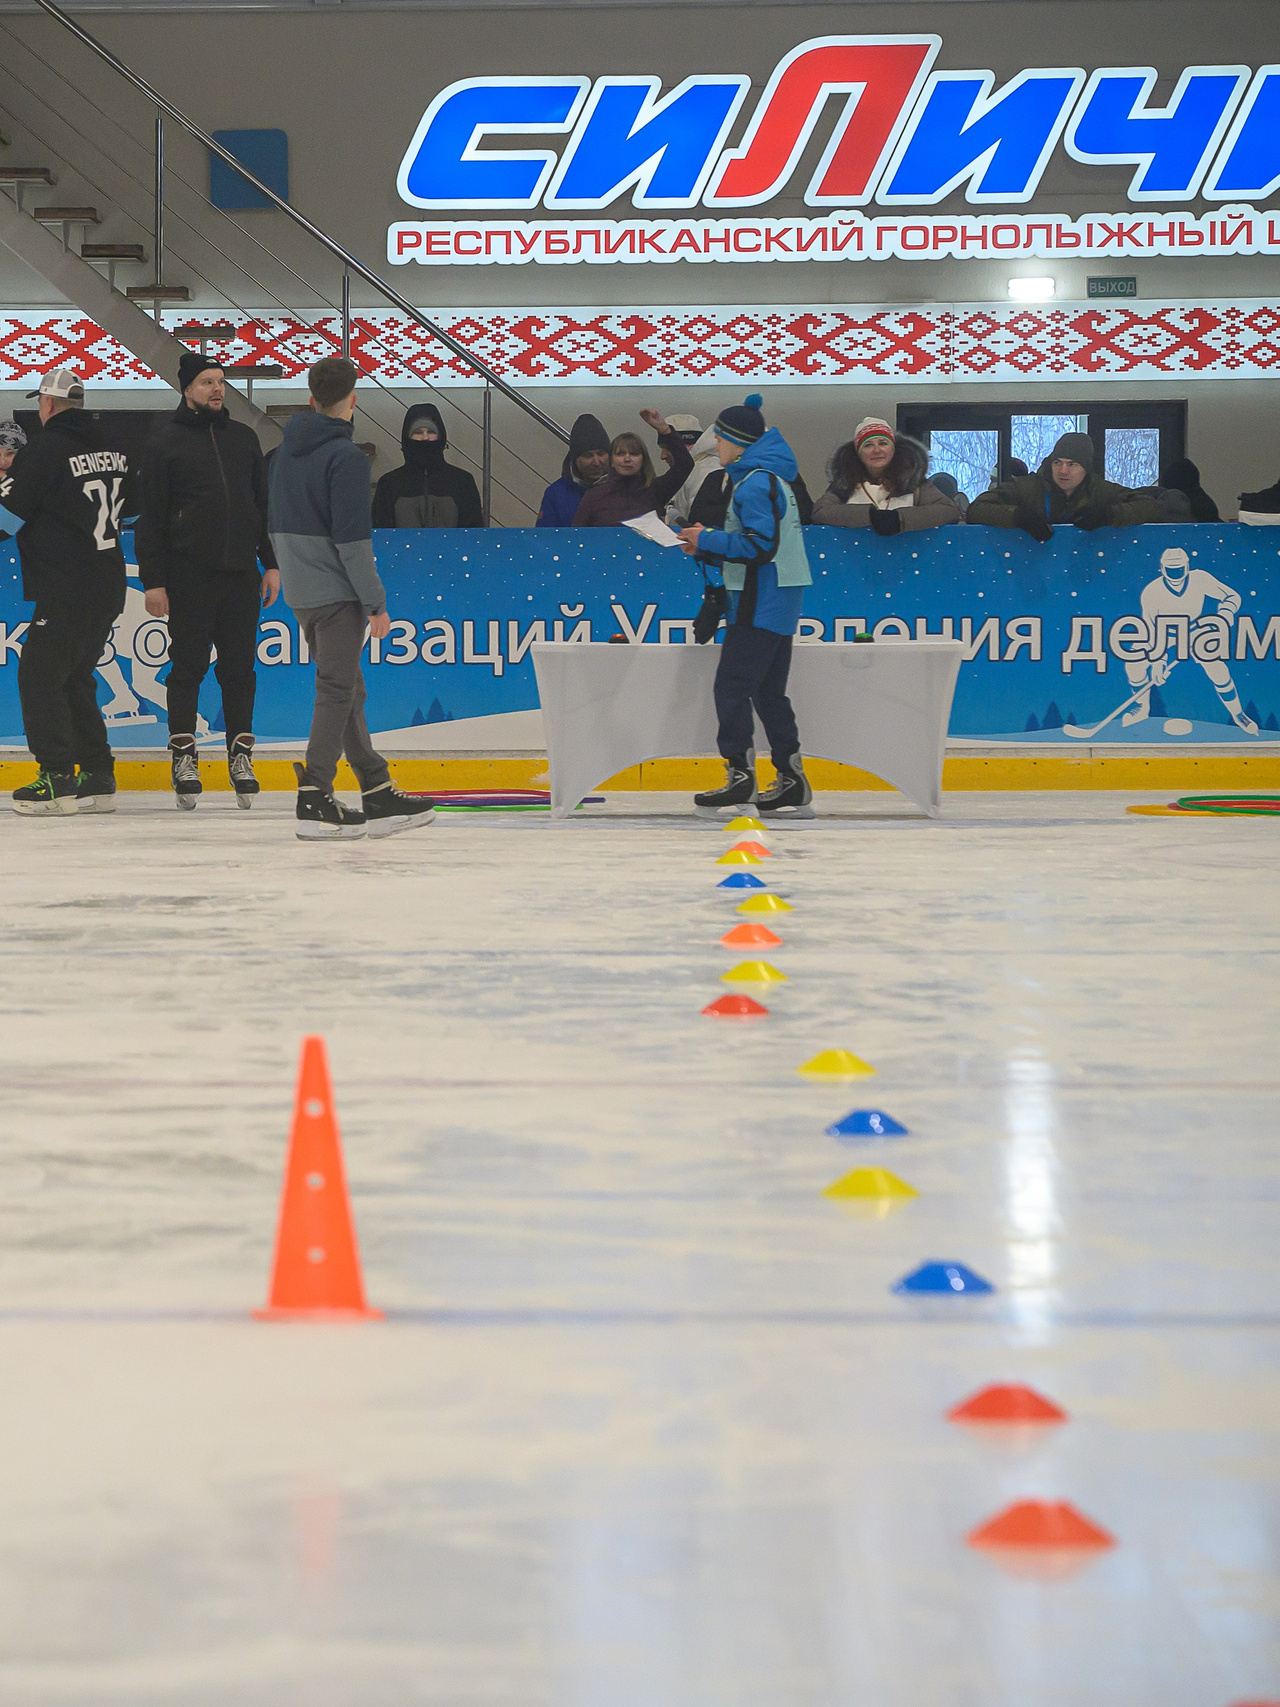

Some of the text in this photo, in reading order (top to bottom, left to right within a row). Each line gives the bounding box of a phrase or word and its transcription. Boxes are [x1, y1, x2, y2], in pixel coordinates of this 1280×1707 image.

[396, 218, 864, 256] РЕСПУБЛИКАНСКИЙ
[875, 213, 1253, 252] ГОРНОЛЫЖНЫЙ
[1089, 281, 1136, 294] ВЫХОД
